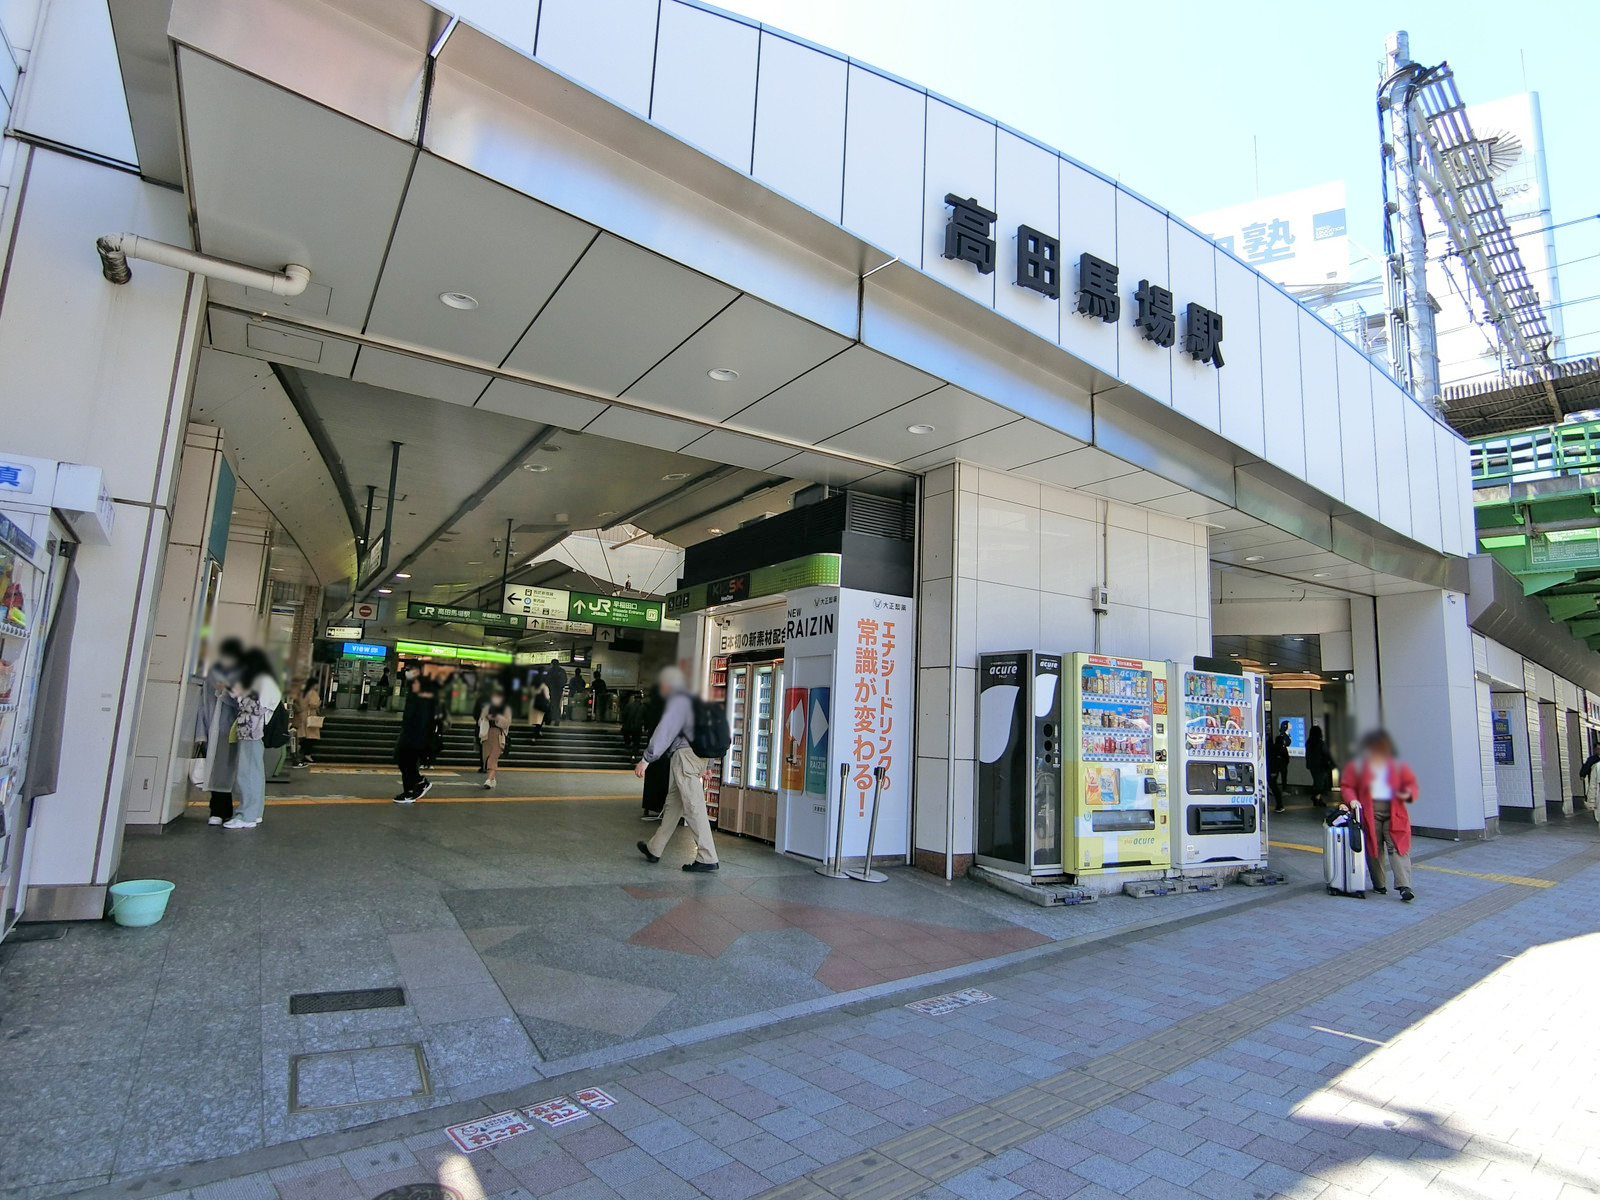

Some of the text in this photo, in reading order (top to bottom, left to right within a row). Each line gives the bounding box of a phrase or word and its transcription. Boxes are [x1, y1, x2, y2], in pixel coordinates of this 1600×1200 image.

[944, 192, 1226, 369] 高田馬場駅
[419, 606, 435, 616] JR
[588, 599, 612, 613] JR
[882, 601, 907, 611] 大正製薬
[787, 607, 802, 618] NEW
[787, 613, 834, 640] RAIZIN
[1039, 660, 1058, 669] acure
[989, 665, 1018, 675] acure
[1119, 670, 1142, 678] acure
[877, 621, 896, 790] エナジードリンクの
[852, 617, 879, 818] 常識が変わる！
[1231, 796, 1254, 804] acure
[1133, 837, 1155, 845] acure
